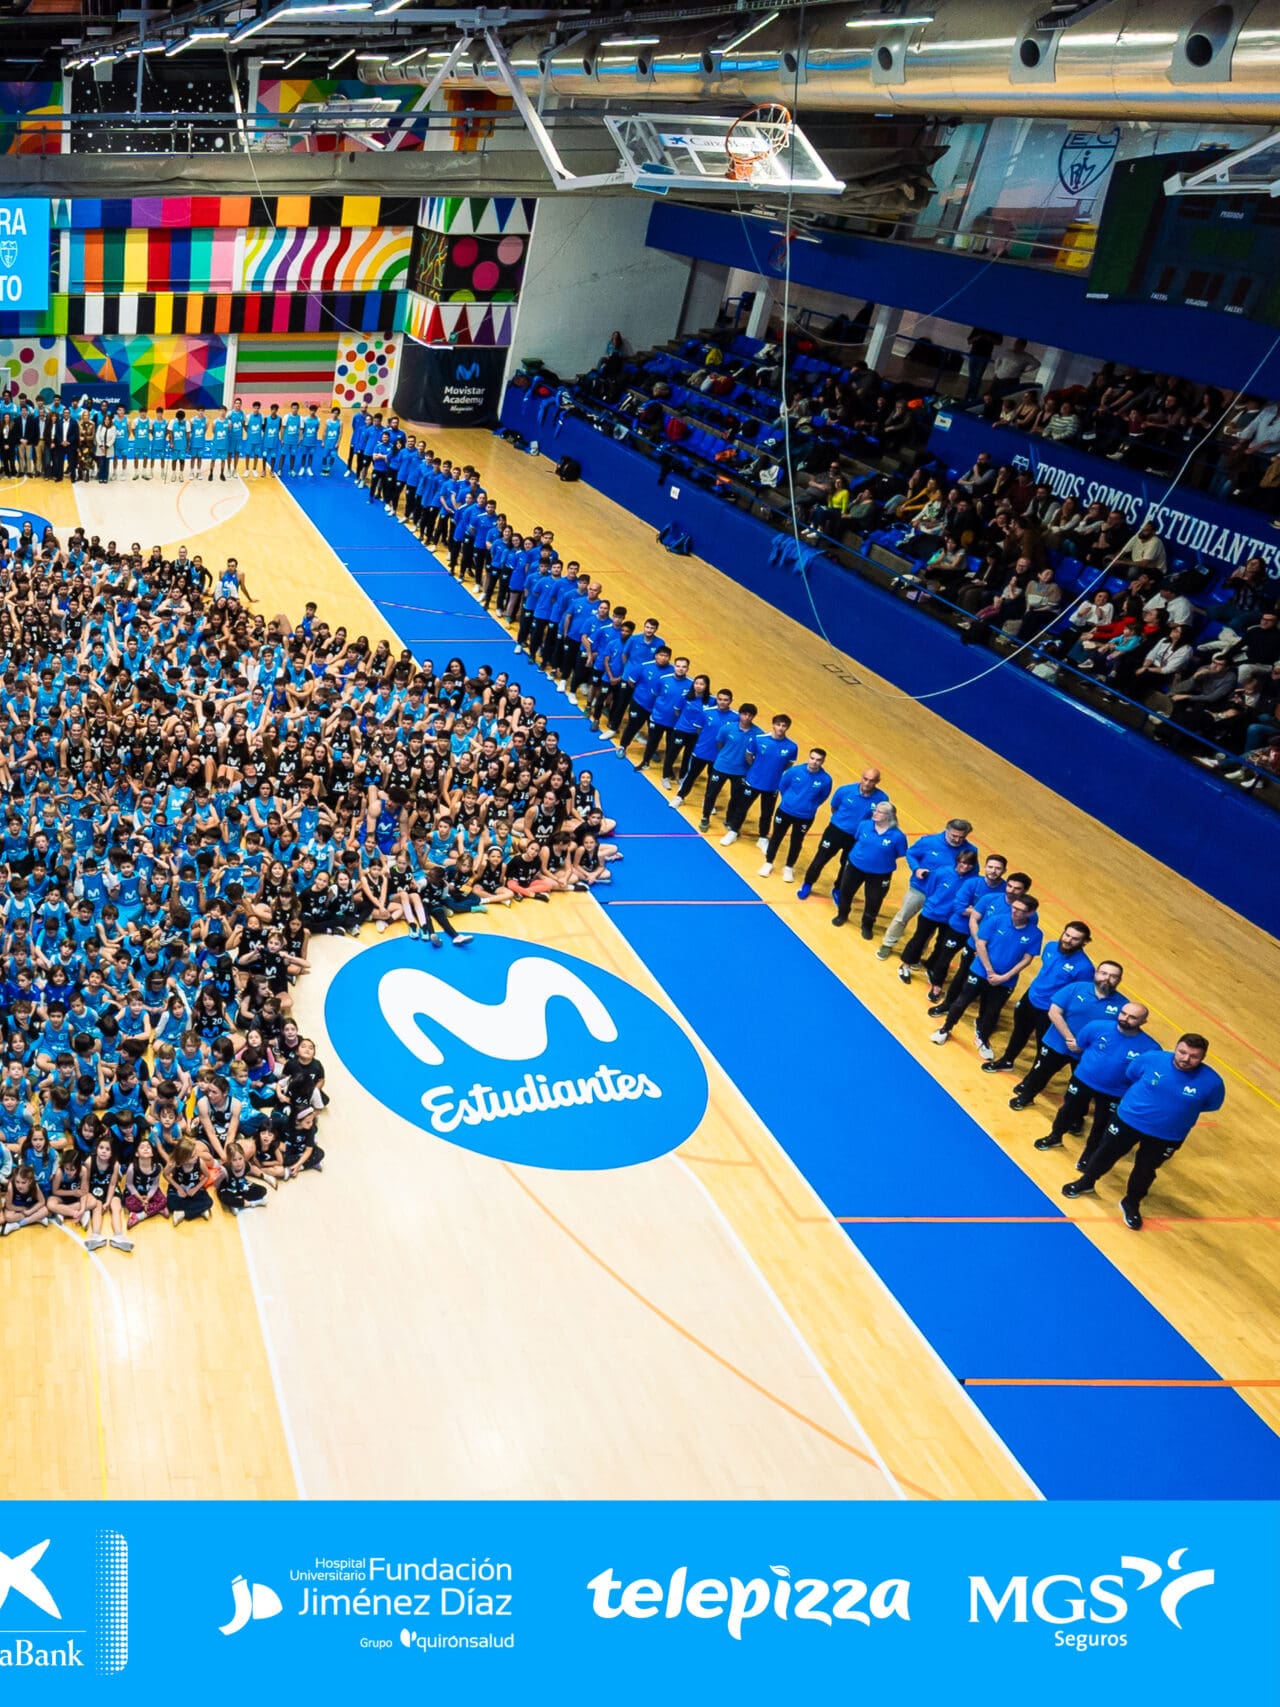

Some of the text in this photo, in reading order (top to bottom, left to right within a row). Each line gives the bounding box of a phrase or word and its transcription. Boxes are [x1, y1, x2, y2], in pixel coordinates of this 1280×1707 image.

[444, 386, 486, 395] Movistar
[442, 395, 484, 405] Academy
[1035, 462, 1085, 499] TODOS
[1082, 481, 1143, 525] SOMOS
[421, 1064, 662, 1132] Estudiantes
[189, 1172, 199, 1181] 15
